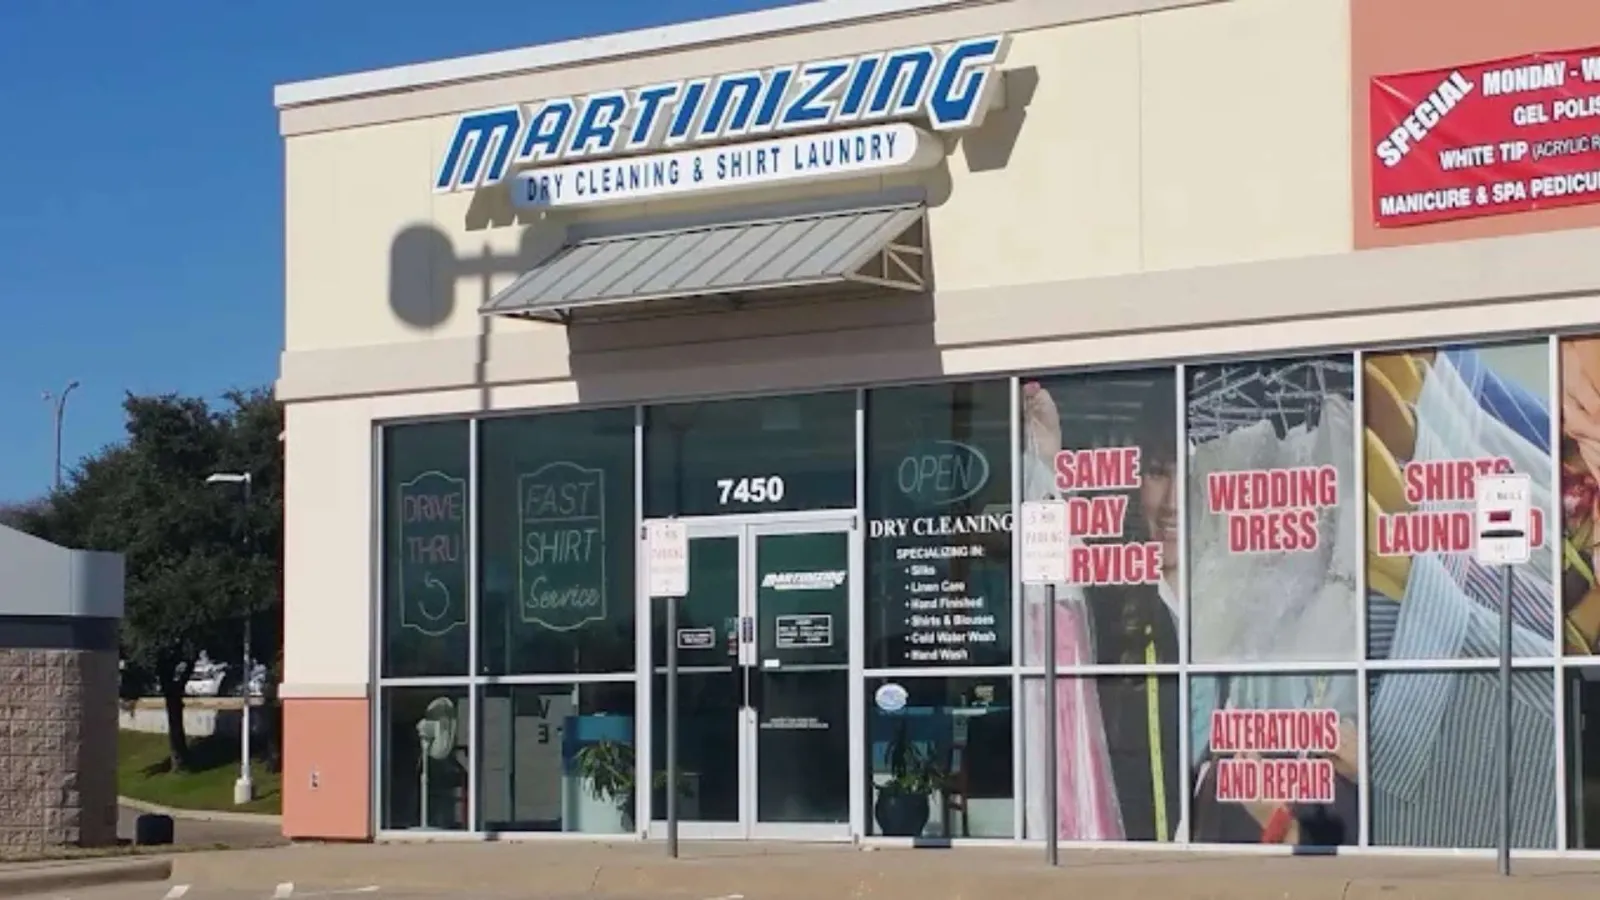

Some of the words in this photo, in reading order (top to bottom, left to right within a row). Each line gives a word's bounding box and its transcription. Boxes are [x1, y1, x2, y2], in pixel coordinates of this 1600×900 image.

[1482, 60, 1566, 96] MONDAY
[436, 38, 1000, 190] MARTINIZING
[1376, 71, 1475, 167] SPECIAL
[1513, 103, 1549, 126] GEL
[526, 174, 563, 203] DRY
[575, 159, 680, 195] CLEANING
[692, 157, 704, 182] &
[716, 147, 781, 180] SHIRT
[794, 131, 898, 170] LAUNDRY
[1439, 145, 1494, 171] WHITE
[1499, 141, 1528, 163] TIP
[1532, 136, 1589, 160] (ACRYLIC
[1380, 188, 1471, 216] MANICURE
[1475, 188, 1489, 205] &
[1492, 180, 1526, 203] SPA
[1530, 171, 1600, 199] PEDICU
[898, 454, 973, 494] OPEN
[1056, 448, 1140, 490] SAME
[403, 492, 461, 523] DRIVE
[525, 481, 596, 515] FAST
[716, 475, 785, 505] 7450
[1208, 468, 1338, 512] WEDDING
[869, 517, 908, 540] DRY
[912, 512, 1014, 537] CLEANING
[1069, 497, 1127, 537] DAY
[1229, 512, 1317, 552] DRESS
[407, 535, 460, 564] THRU
[524, 527, 599, 567] SHIRT
[896, 545, 968, 559] SPECIALIZING
[1072, 544, 1162, 583] RVICE
[526, 574, 600, 610] Service
[1212, 710, 1338, 751] ALTERATIONS
[1218, 761, 1258, 800] AND
[1263, 760, 1333, 800] REPAIR
